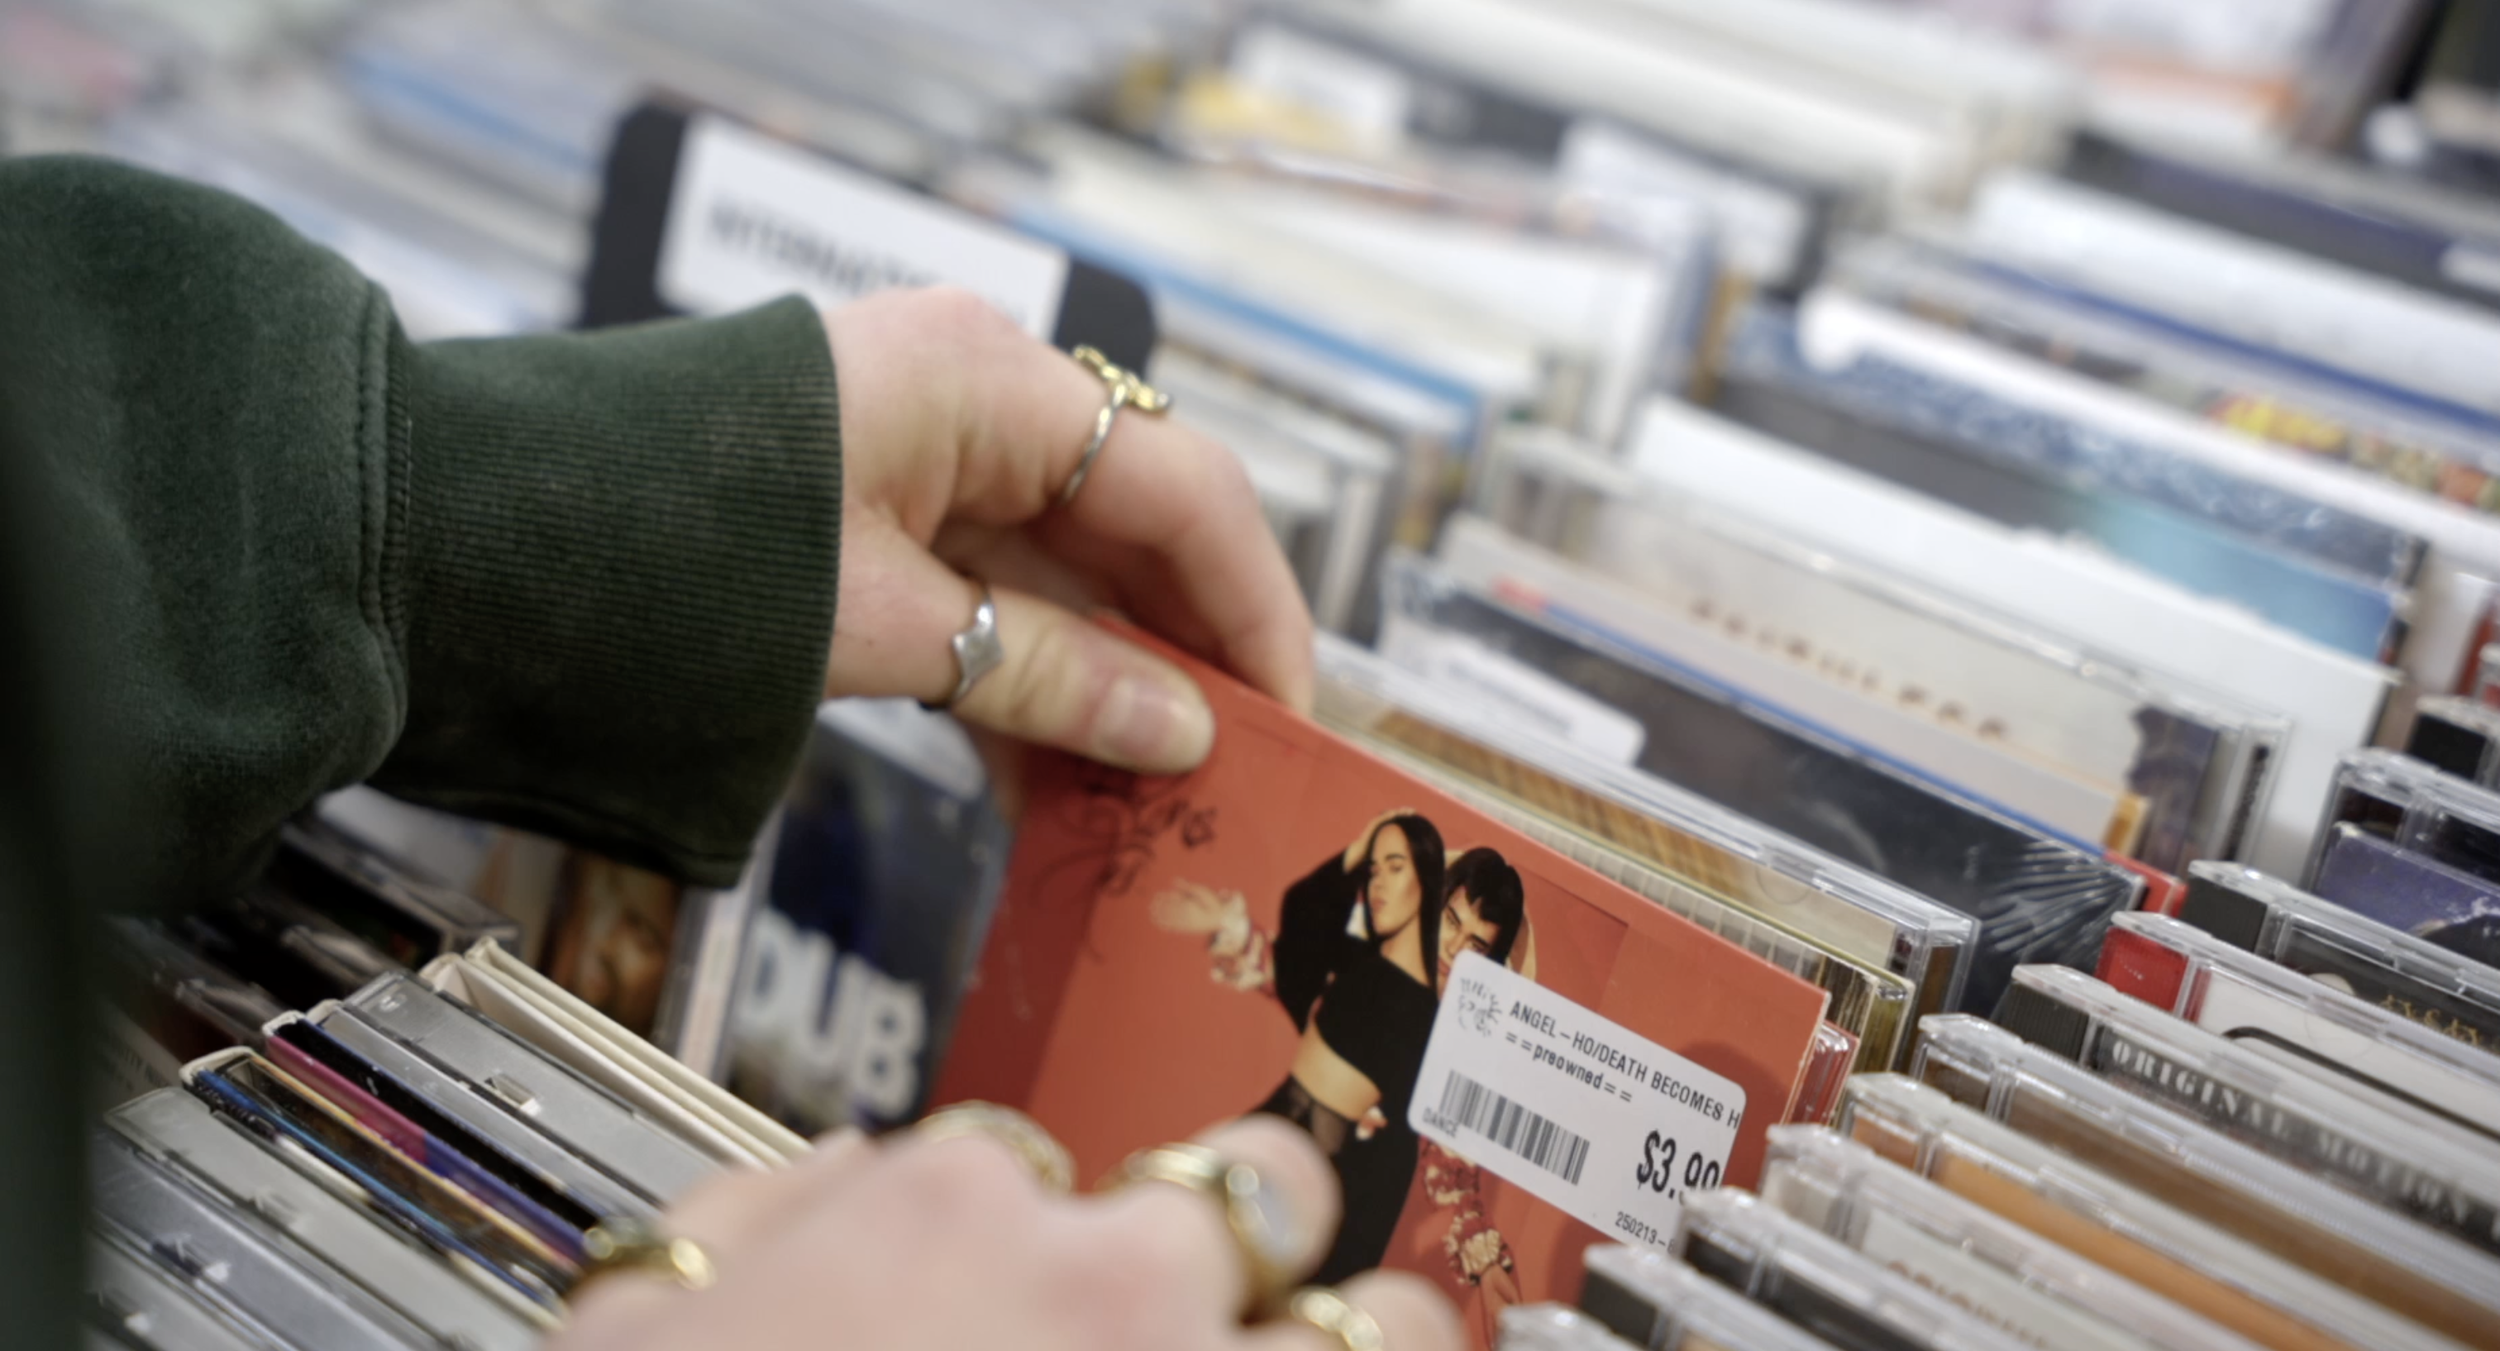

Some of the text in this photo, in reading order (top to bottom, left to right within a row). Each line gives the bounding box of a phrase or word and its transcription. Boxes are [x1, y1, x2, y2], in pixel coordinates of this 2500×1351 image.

[734, 908, 925, 1117] DUB
[1510, 1001, 1741, 1129] ANGEL-HO/DEATH BECOMES H
[1423, 1106, 1459, 1138] DANCE
[2113, 1039, 2471, 1225] ORIGINAL MOTION
